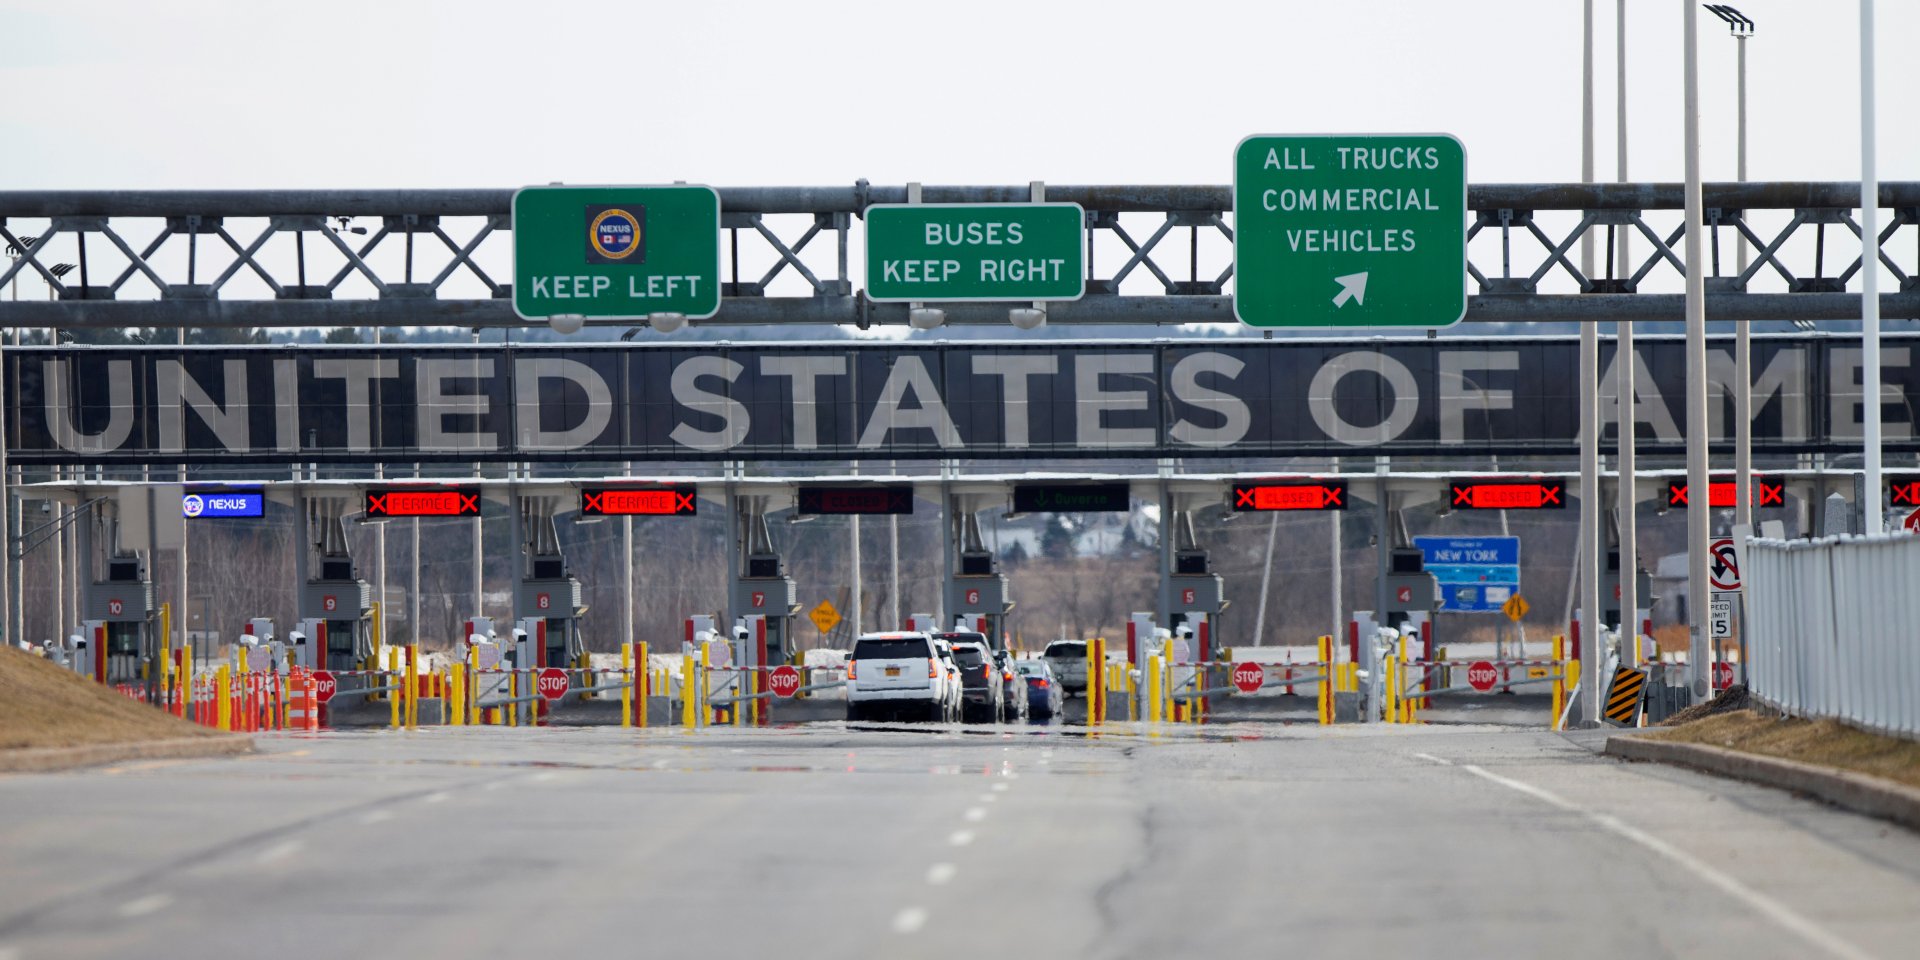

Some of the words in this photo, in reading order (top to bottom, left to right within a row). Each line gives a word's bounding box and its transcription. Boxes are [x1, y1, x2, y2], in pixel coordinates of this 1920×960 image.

[1263, 147, 1315, 170] ALL
[1337, 146, 1439, 170] TRUCKS
[1262, 188, 1439, 211] COMMERCIAL
[600, 224, 631, 233] NEXUS
[925, 222, 1024, 246] BUSES
[1286, 229, 1416, 252] VEHICLES
[883, 259, 961, 283] KEEP
[980, 258, 1065, 282] RIGHT
[532, 275, 611, 299] KEEP
[629, 275, 702, 298] LEFT
[42, 356, 613, 455] UNITED
[668, 351, 1252, 452] STATES
[1308, 349, 1520, 447] OF
[1574, 347, 1912, 444] AME
[208, 499, 247, 510] NEXUS
[1265, 492, 1314, 504] CLOSED
[1434, 549, 1462, 561] NEW
[1464, 549, 1498, 561] YORK
[540, 596, 549, 608] 8
[755, 594, 764, 607] 7
[969, 592, 978, 604] 6
[1186, 591, 1194, 604] 5
[1400, 590, 1410, 602] 4
[110, 601, 122, 614] 10
[326, 598, 336, 610] 9
[1711, 603, 1730, 611] PEED
[771, 674, 798, 688] STOP
[1235, 670, 1263, 684] STOP
[1469, 669, 1497, 683] STOP
[316, 680, 334, 693] TOP
[539, 677, 567, 690] STOP
